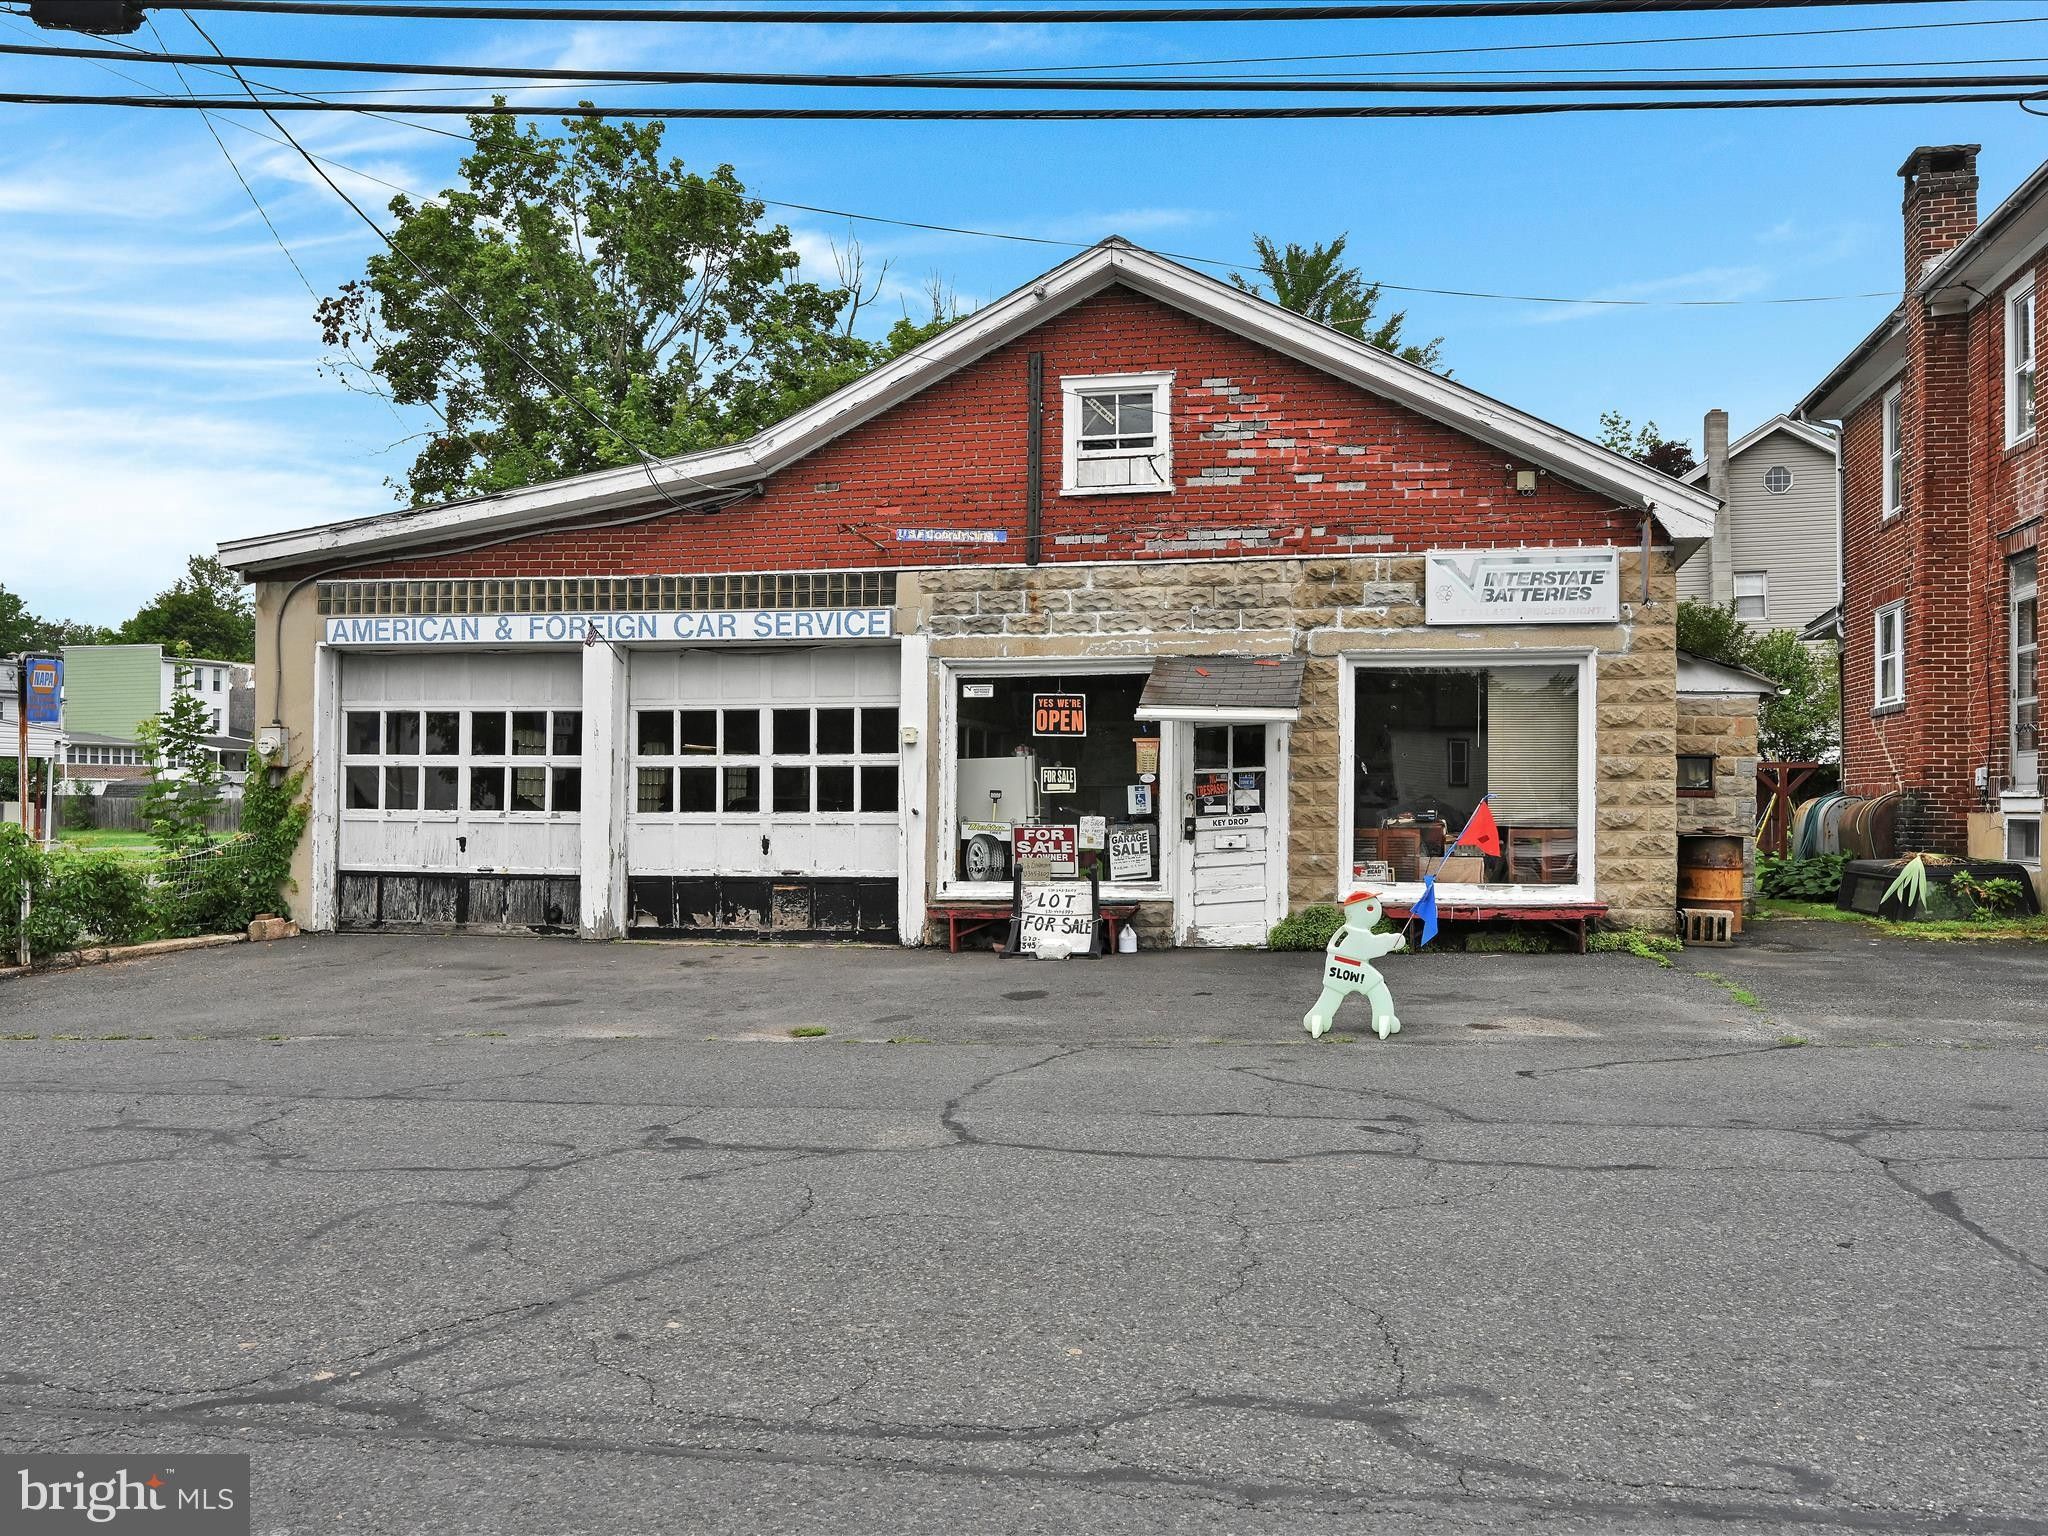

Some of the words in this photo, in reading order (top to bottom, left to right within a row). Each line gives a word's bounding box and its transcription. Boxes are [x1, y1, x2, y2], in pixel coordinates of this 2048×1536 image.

[1484, 570, 1605, 587] INTERSTATE
[1480, 586, 1593, 603] BATTERIES
[331, 616, 479, 642] AMERICAN
[495, 617, 512, 640] &
[529, 614, 657, 640] FOREIGN
[673, 613, 736, 639] CAR
[753, 609, 886, 638] SERVICE
[33, 671, 54, 687] NAPA
[1038, 699, 1054, 708] YES
[1057, 698, 1081, 708] WE'RE
[1036, 709, 1083, 731] OPEN
[1043, 770, 1057, 783] FOR
[1058, 770, 1074, 783] SALE
[1212, 819, 1226, 827] KEY
[1228, 818, 1249, 826] DROP
[1024, 829, 1065, 841] FOR
[1111, 832, 1148, 845] GARAGE
[1016, 841, 1074, 853] SALE
[1112, 842, 1149, 857] SALE
[1037, 892, 1076, 908] LOT
[1023, 915, 1056, 933] FOR
[1061, 917, 1092, 935] SALE
[1329, 967, 1365, 984] SLOW!
